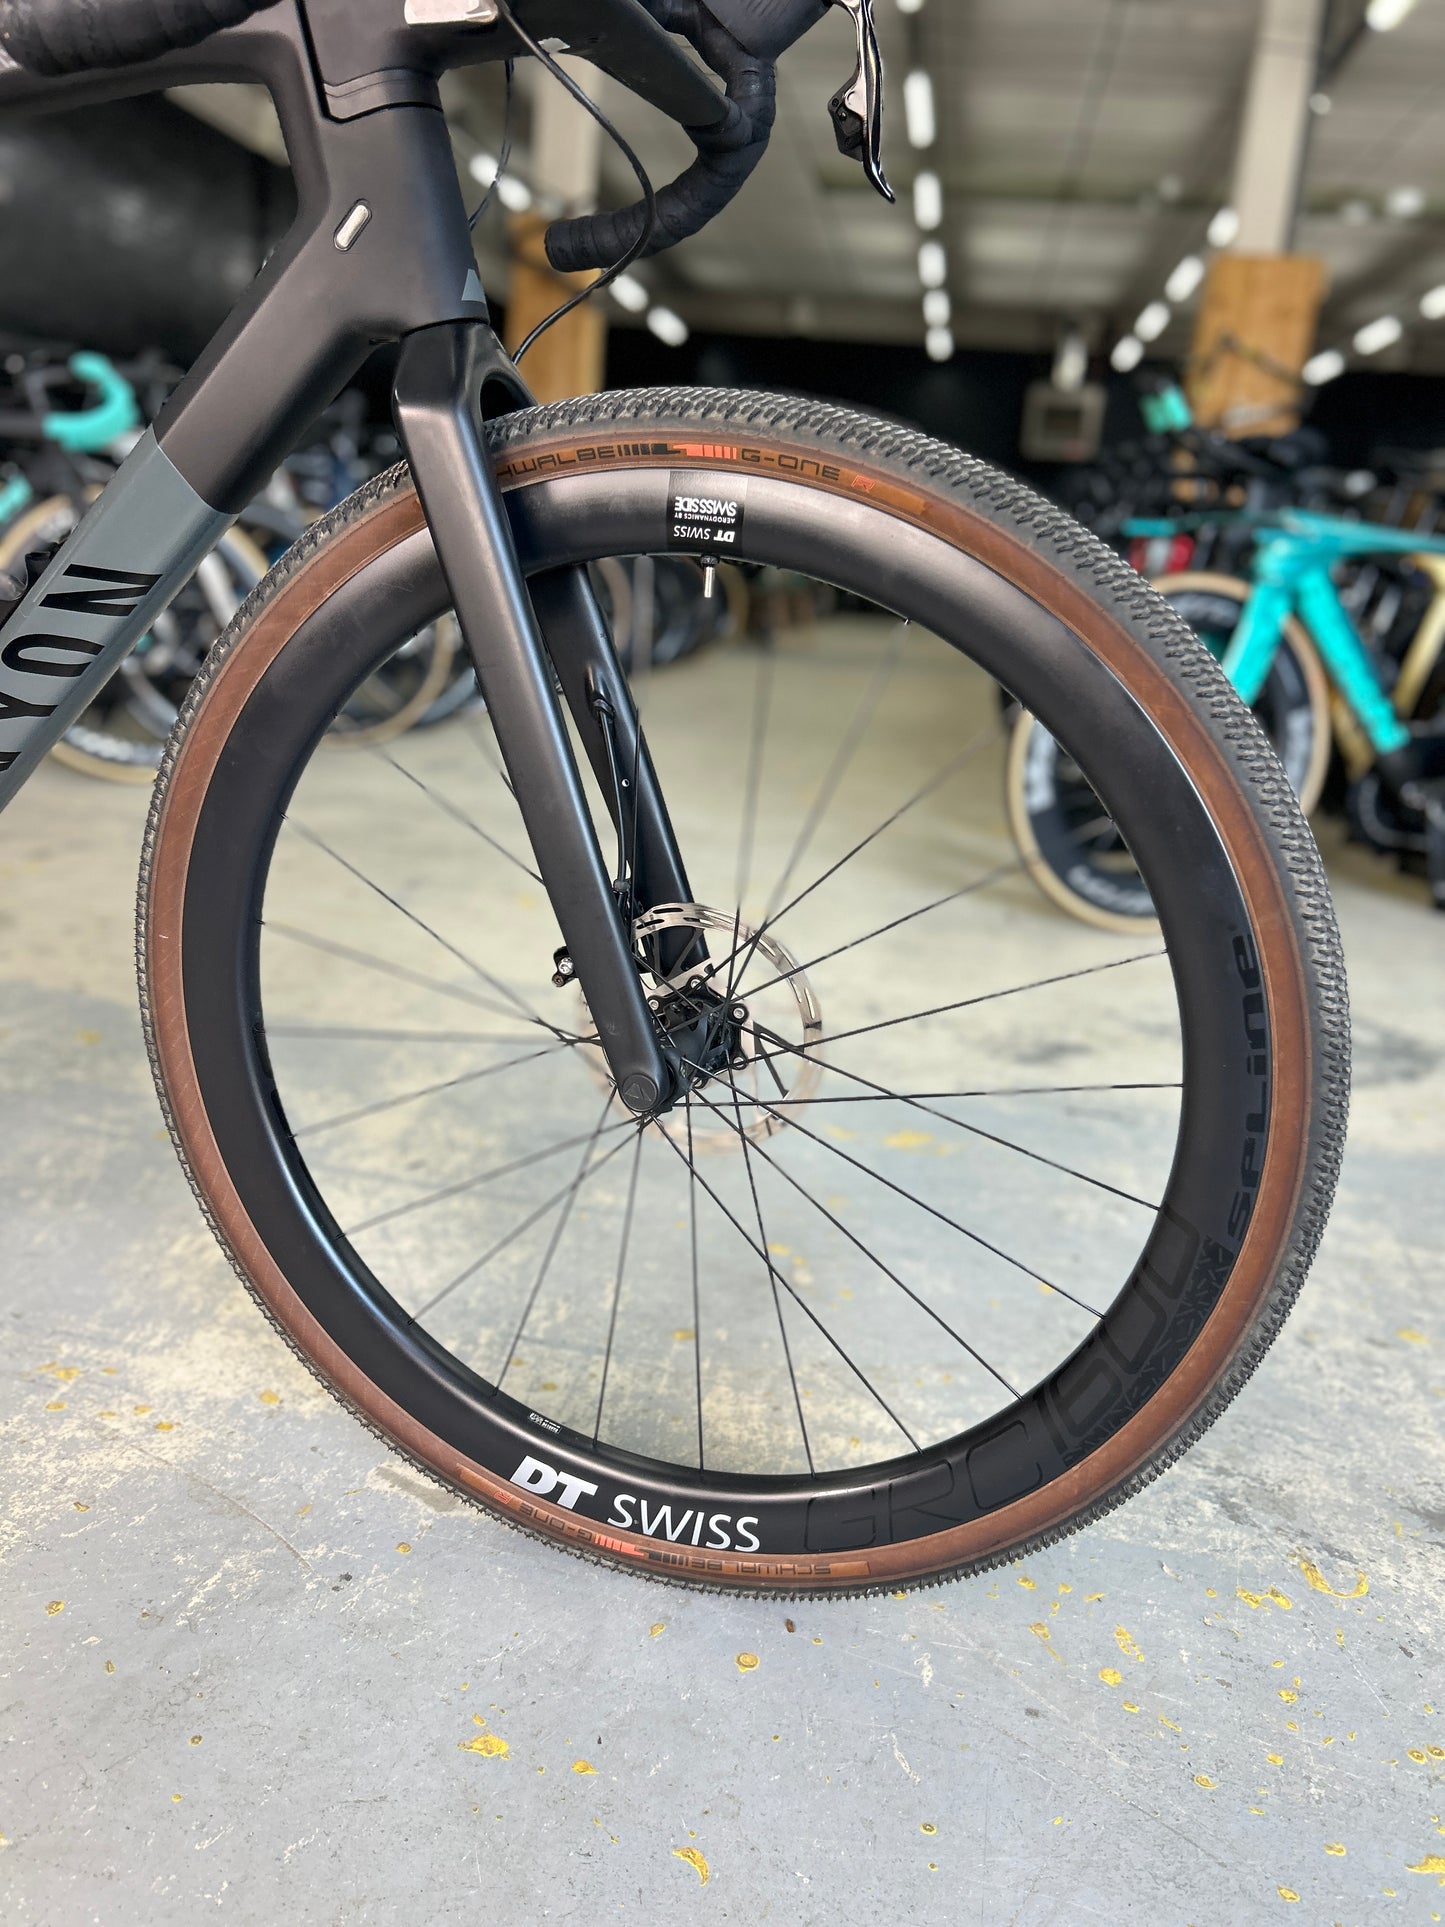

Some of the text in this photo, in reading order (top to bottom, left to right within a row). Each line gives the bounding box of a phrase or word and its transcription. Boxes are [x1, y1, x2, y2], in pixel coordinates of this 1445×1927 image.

[673, 525, 736, 543] DT SWISS
[674, 511, 736, 524] AERODYNAMICS BY
[0, 563, 163, 772] YON
[509, 1456, 761, 1553] DT SWISS
